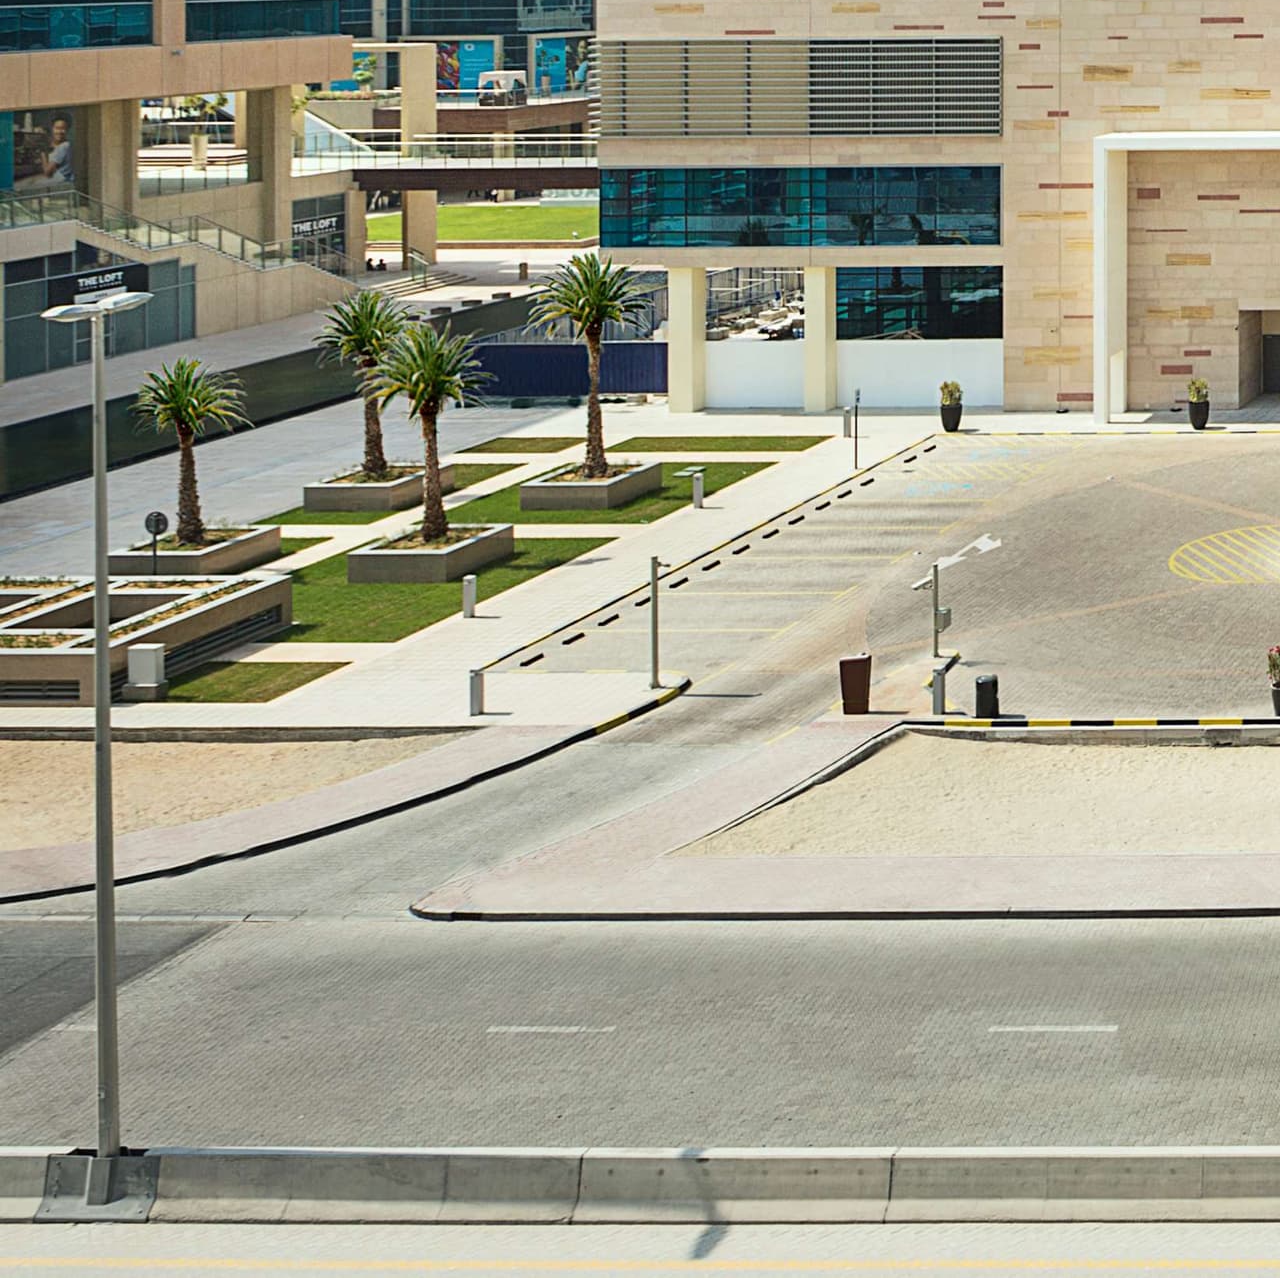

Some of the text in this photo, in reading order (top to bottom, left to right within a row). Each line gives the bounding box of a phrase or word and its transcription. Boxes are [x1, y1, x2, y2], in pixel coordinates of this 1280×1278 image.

[293, 222, 312, 233] THE
[313, 217, 337, 229] LOFT
[78, 276, 98, 286] THE
[99, 272, 124, 283] LOFT
